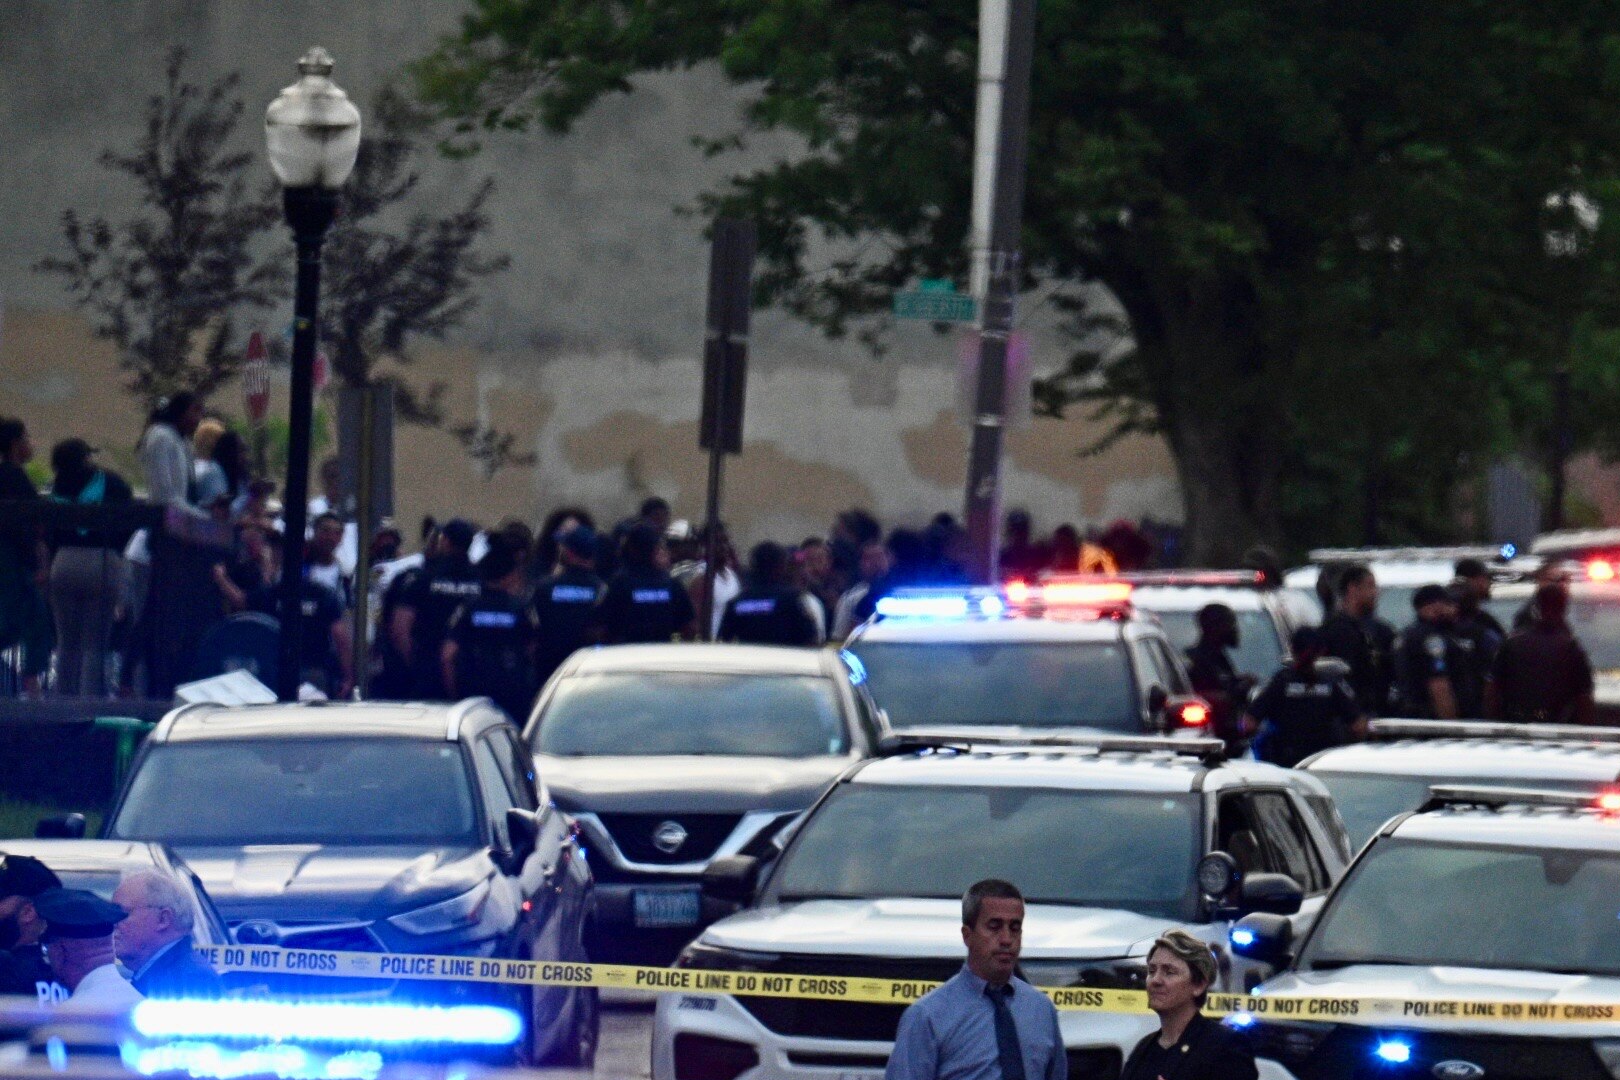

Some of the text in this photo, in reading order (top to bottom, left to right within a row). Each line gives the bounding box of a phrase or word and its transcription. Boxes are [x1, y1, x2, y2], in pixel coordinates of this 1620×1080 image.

[224, 949, 245, 966] DO
[251, 950, 280, 968] NOT
[286, 951, 337, 970] CROSS
[380, 956, 593, 982] POLICE LINE DO NOT CROSS
[635, 970, 847, 995] POLICE LINE DO NOT CROSS
[1053, 990, 1104, 1007] CROSS
[1206, 996, 1359, 1015] LINE DO NOT CROSS
[1403, 1001, 1614, 1018] POLICE LINE DO NOT CROSS
